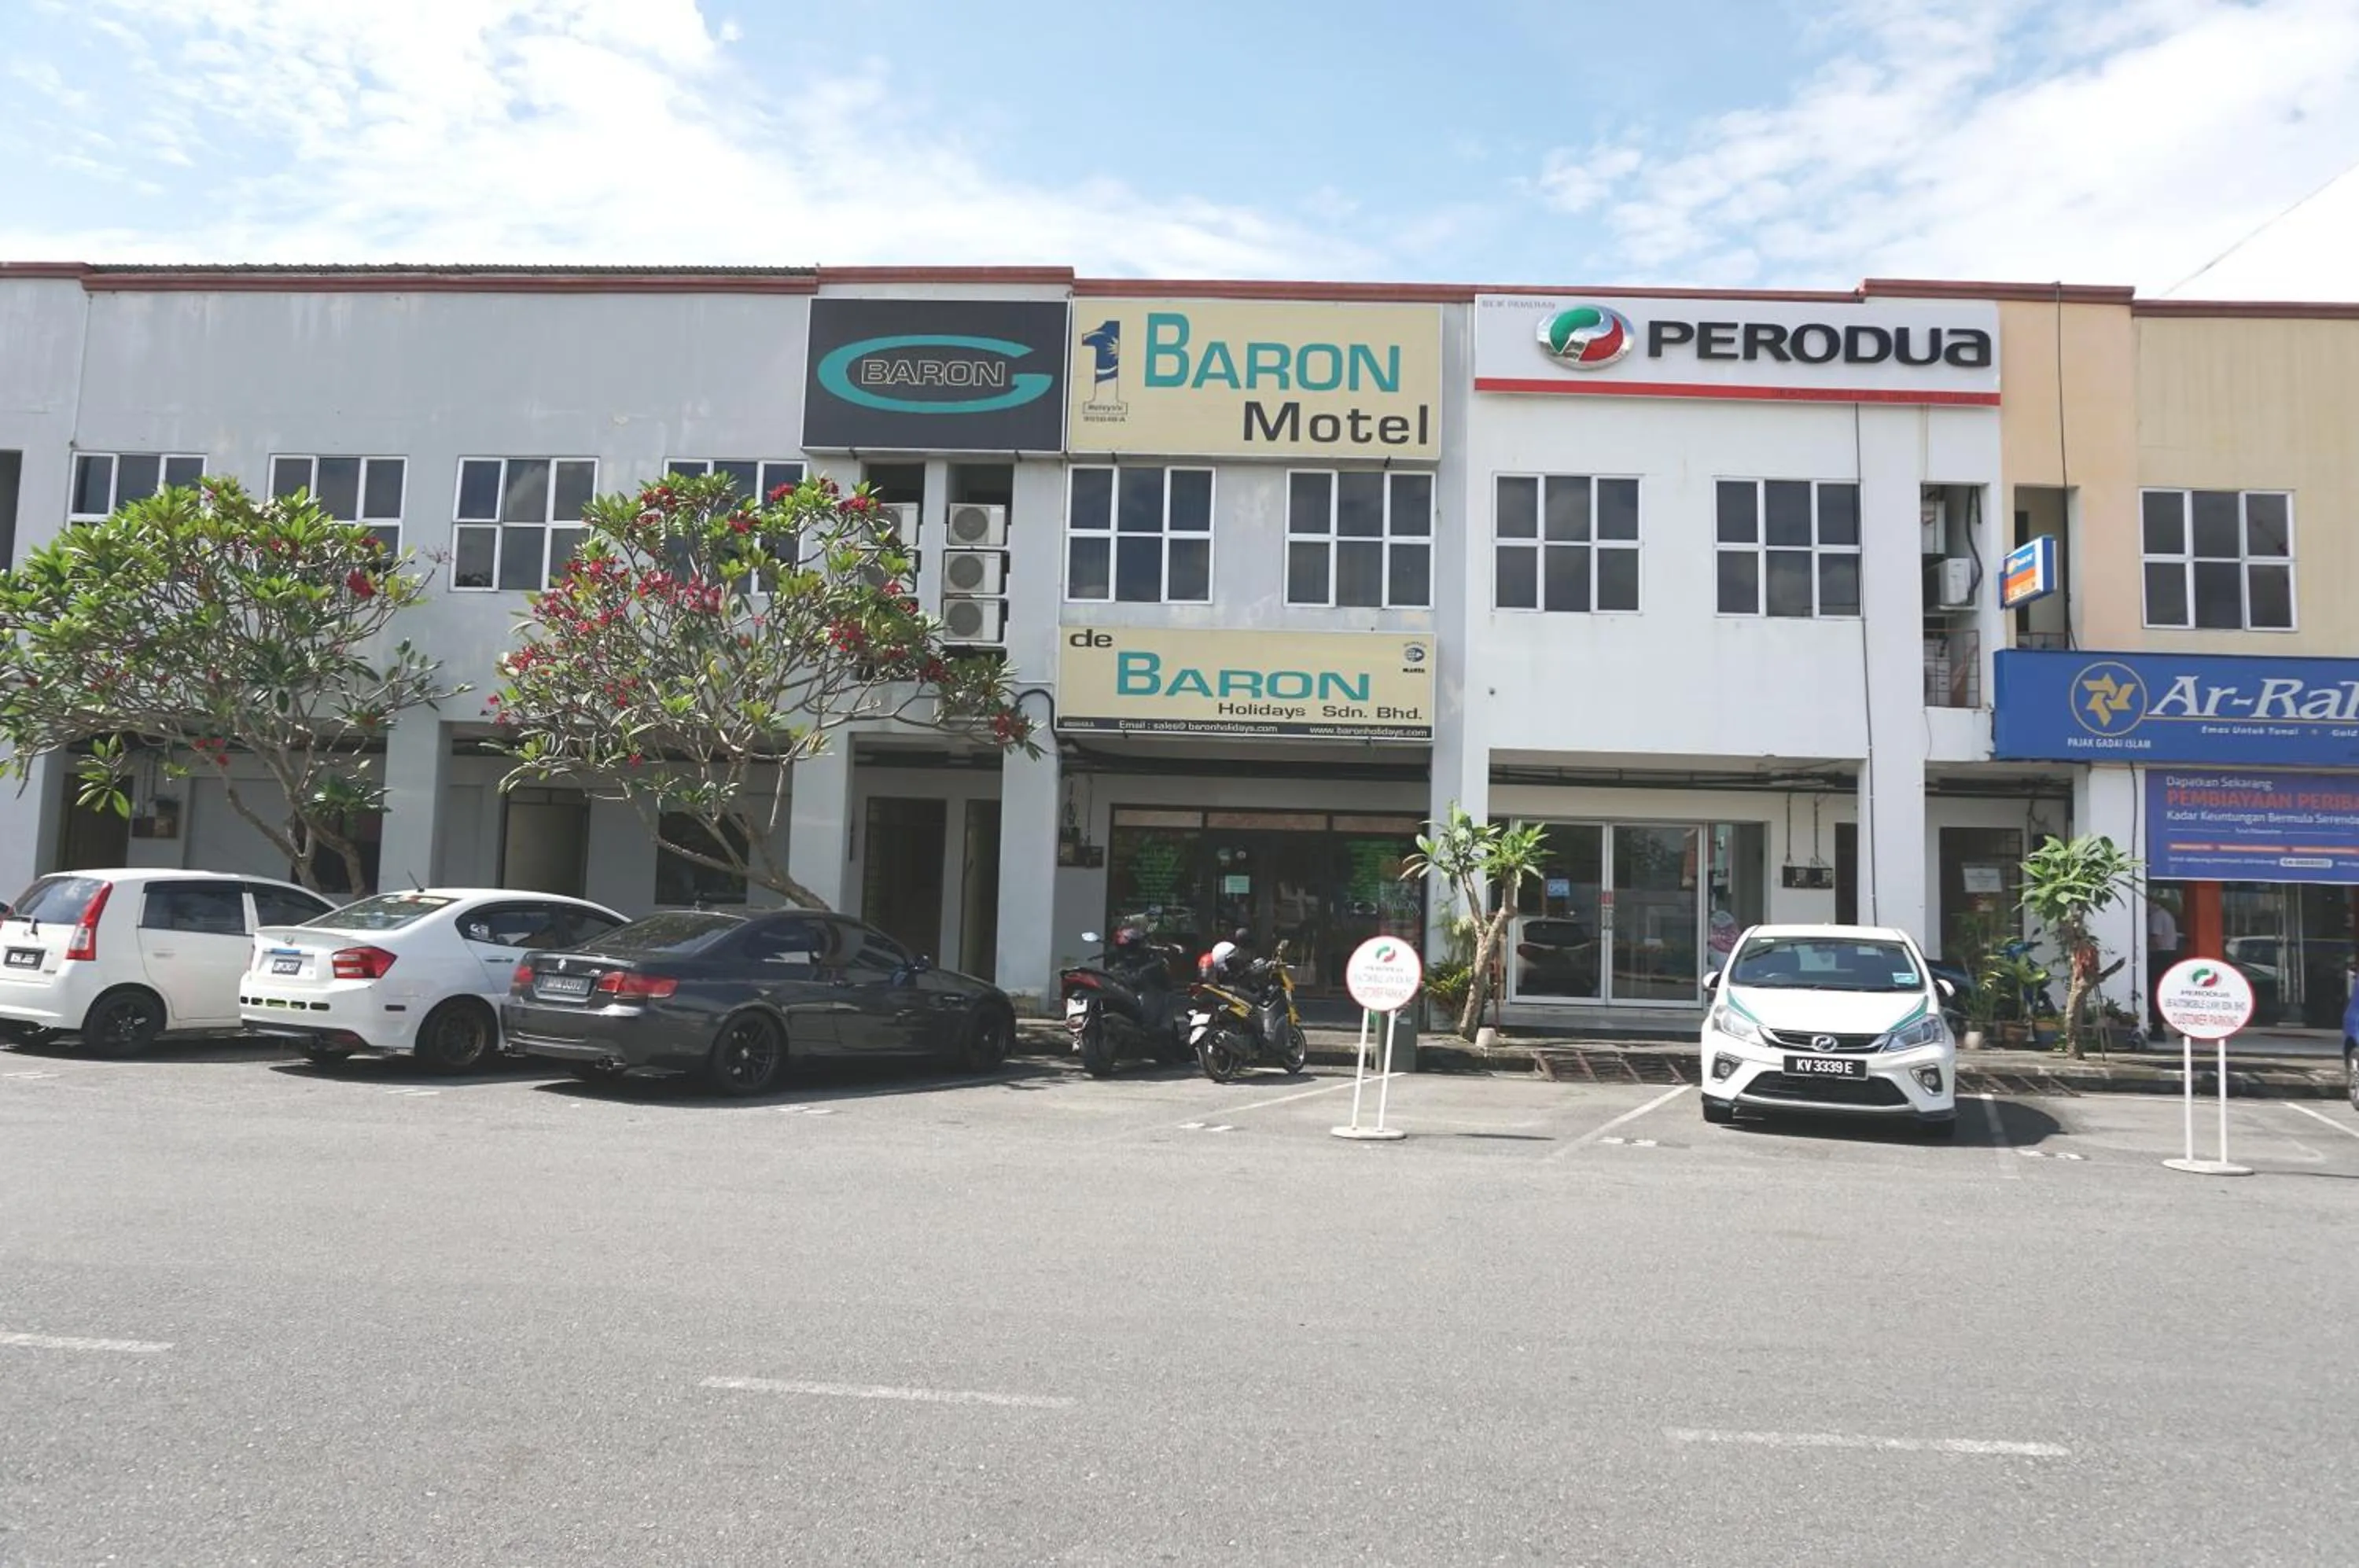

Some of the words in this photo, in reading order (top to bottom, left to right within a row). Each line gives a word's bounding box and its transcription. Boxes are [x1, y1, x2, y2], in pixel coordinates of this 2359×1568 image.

[1144, 312, 1400, 392] BARON
[860, 359, 1006, 387] BARON
[1243, 401, 1428, 445] Motel
[1069, 629, 1113, 647] de
[1116, 651, 1369, 701] BARON
[1218, 702, 1306, 718] Holidays
[1322, 705, 1368, 718] Sdn.
[1377, 706, 1422, 720] Bhd.
[1309, 727, 1428, 737] www.baronholidays.com
[2096, 738, 2122, 748] GADAI
[2166, 811, 2197, 820] Kadar
[2201, 811, 2265, 824] Keuntungan
[1796, 1058, 1812, 1071] KV
[1813, 1060, 1843, 1073] 3339
[1845, 1062, 1853, 1074] E
